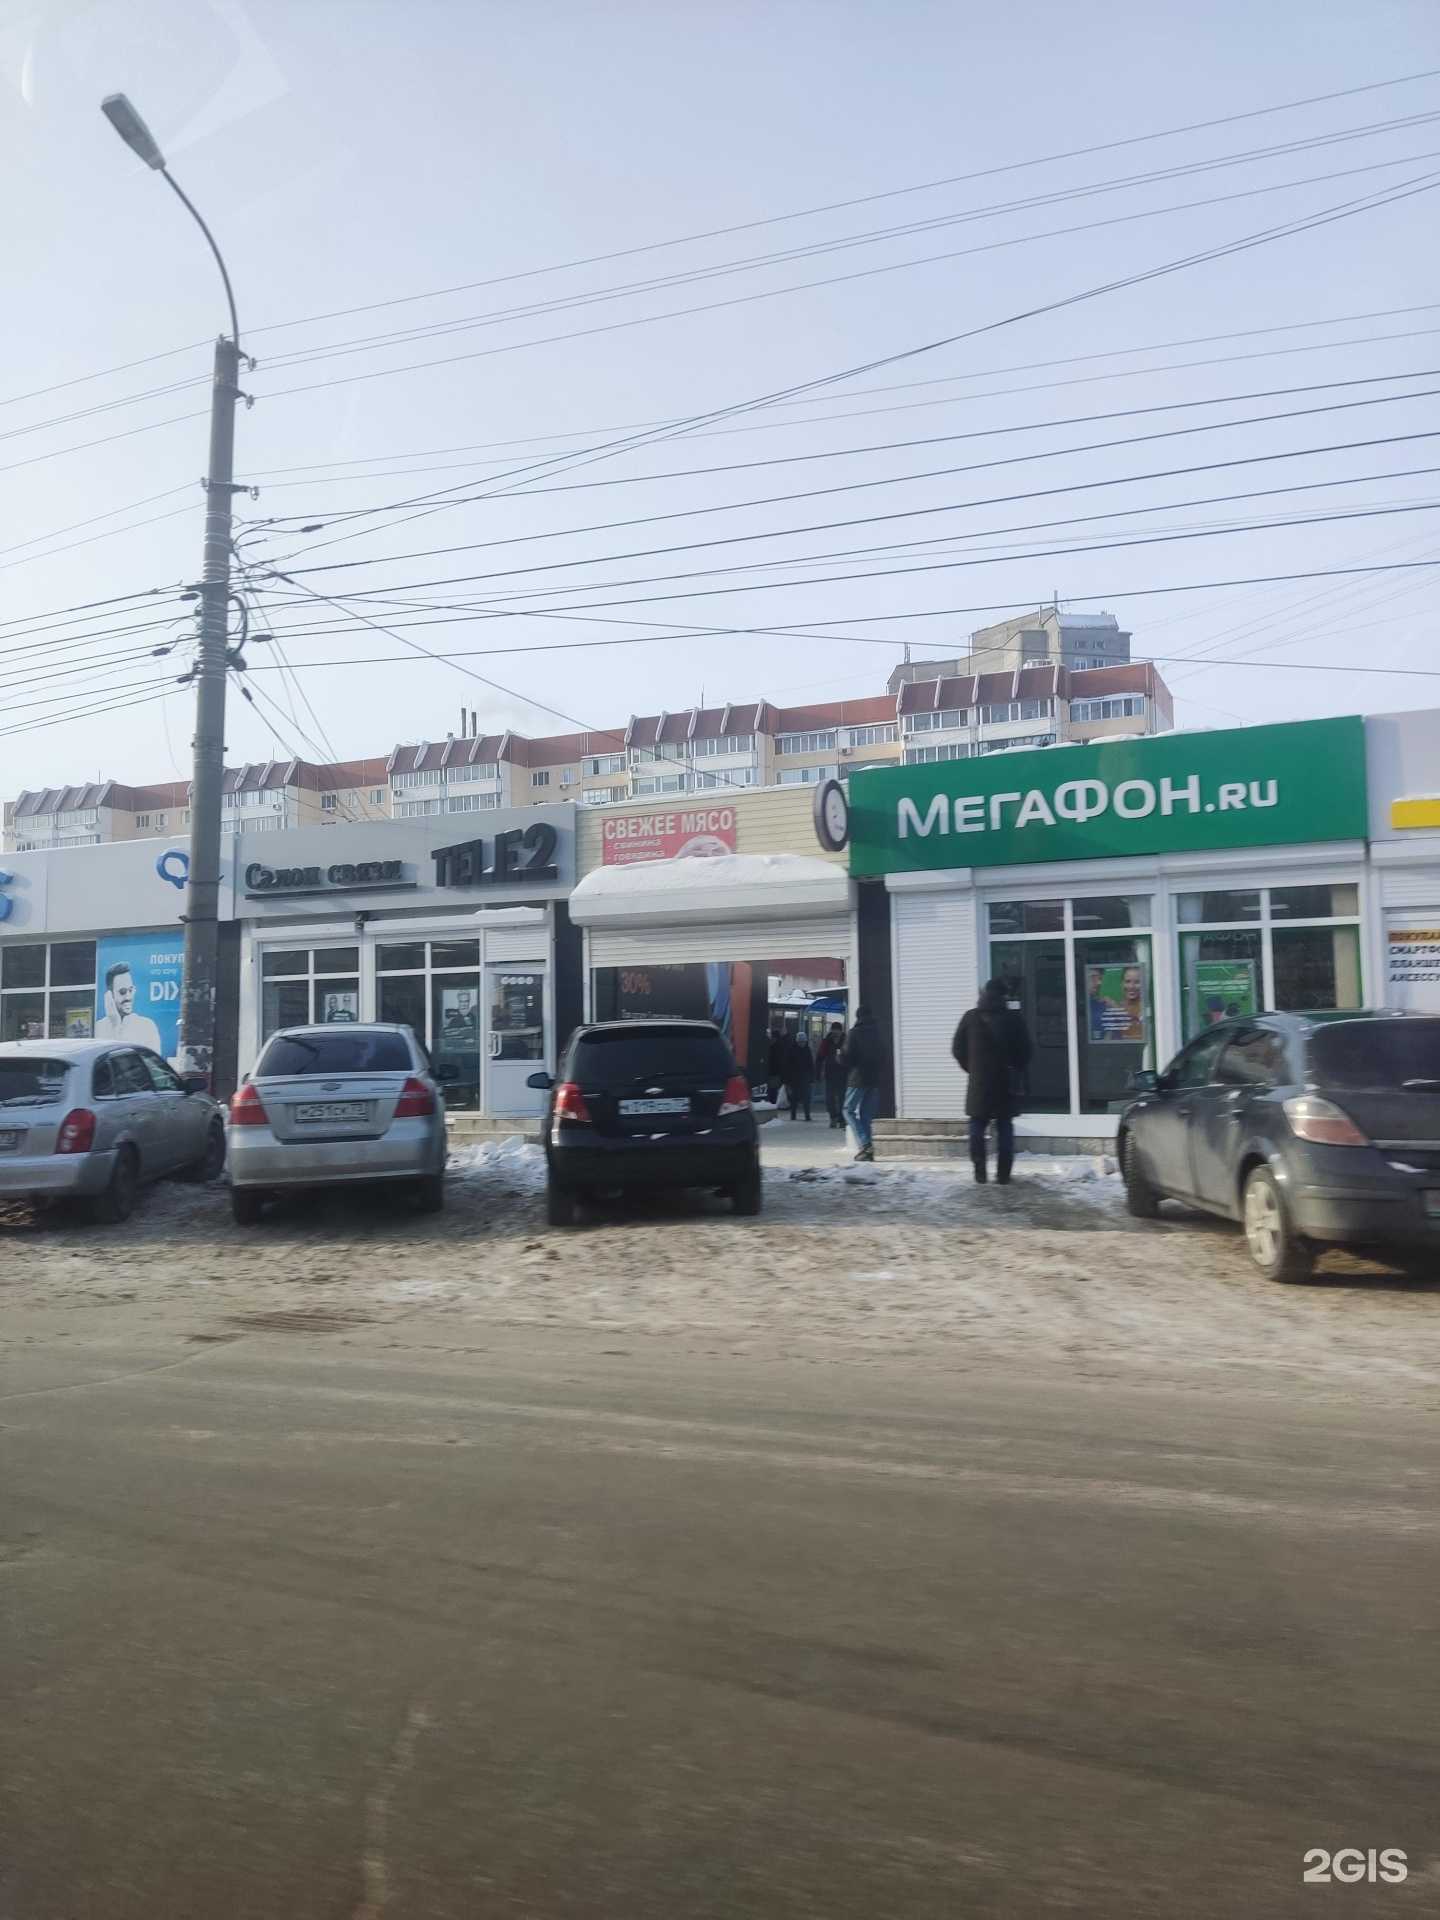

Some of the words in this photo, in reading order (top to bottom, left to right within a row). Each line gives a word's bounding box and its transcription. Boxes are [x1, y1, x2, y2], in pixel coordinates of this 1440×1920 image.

[604, 815, 676, 839] СВЕЖЕЕ
[681, 810, 732, 834] МЯСО
[431, 822, 558, 887] TELE2
[245, 862, 321, 891] Салон
[327, 859, 403, 884] связи
